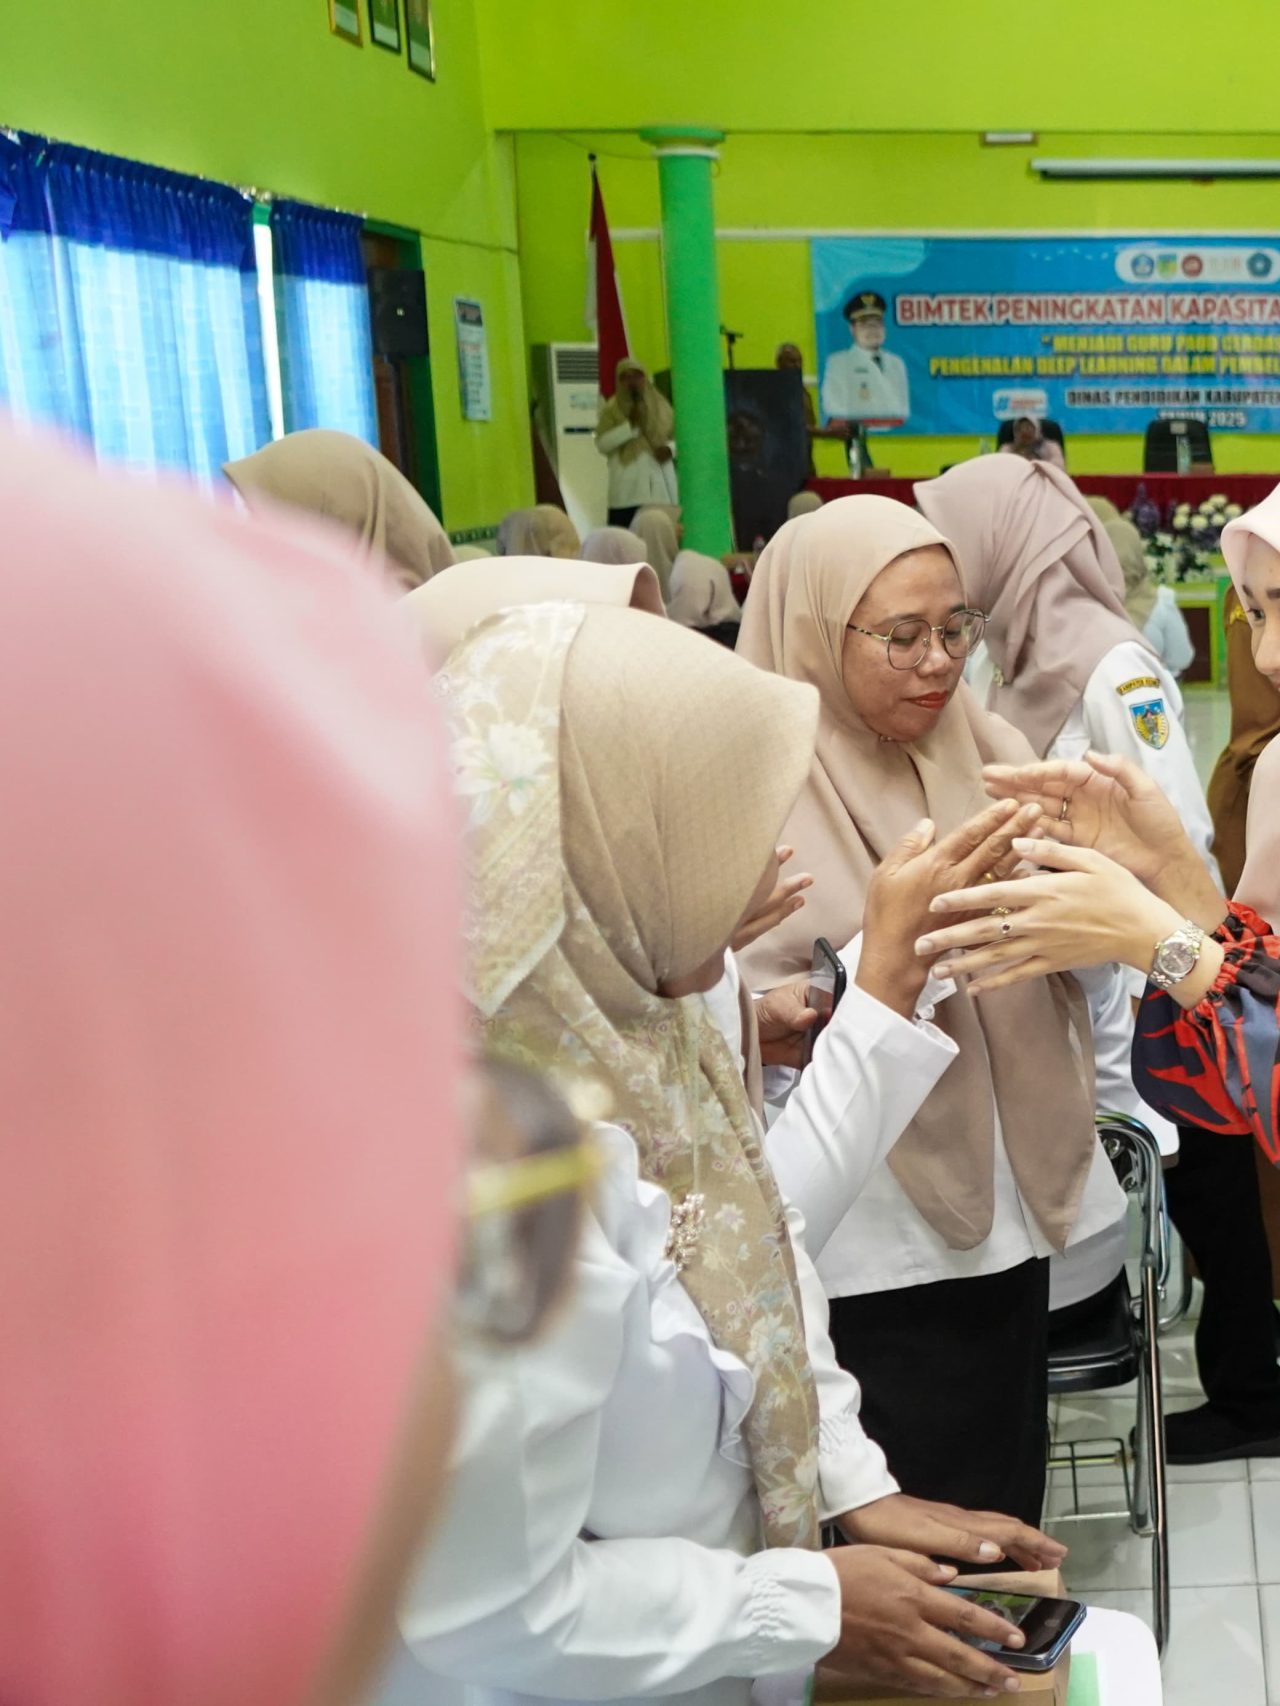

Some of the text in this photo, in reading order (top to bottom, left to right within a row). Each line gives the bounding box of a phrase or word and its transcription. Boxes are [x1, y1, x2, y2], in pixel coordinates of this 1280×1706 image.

[898, 297, 991, 323] BIMTEK
[999, 297, 1164, 323] PENINGKATAN
[1037, 357, 1076, 376] DEEP
[1080, 357, 1157, 375] LEARNING
[1161, 357, 1216, 374] DALAM
[1067, 390, 1111, 405] DINAS
[1115, 390, 1200, 405] PENDIDIKAN
[1210, 411, 1247, 427] 2025
